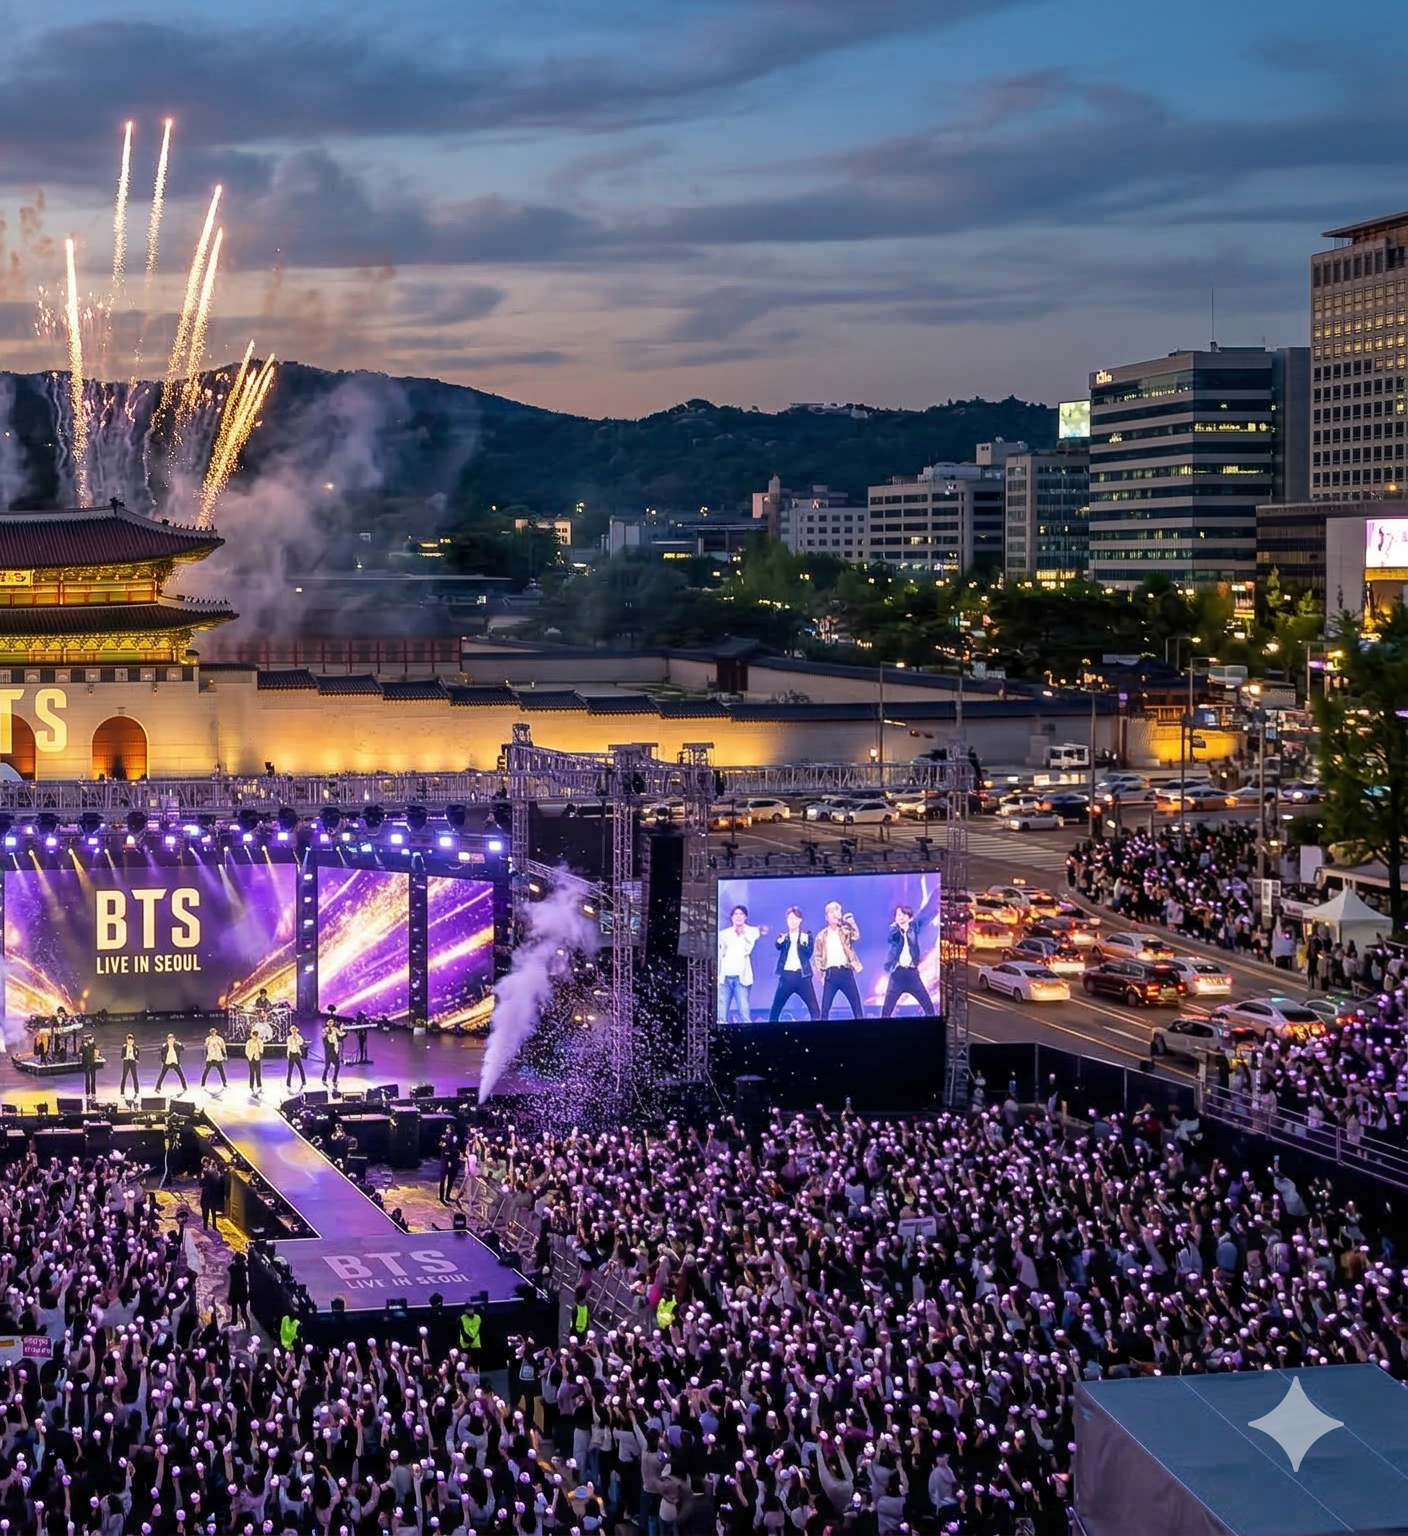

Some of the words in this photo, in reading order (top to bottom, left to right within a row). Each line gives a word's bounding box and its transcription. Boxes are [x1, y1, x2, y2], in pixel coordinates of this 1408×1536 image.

[96, 887, 201, 951] BTS
[96, 955, 129, 975] LIVE
[134, 955, 150, 973] IN
[154, 953, 202, 973] SEOUL
[322, 1250, 459, 1280] BTS
